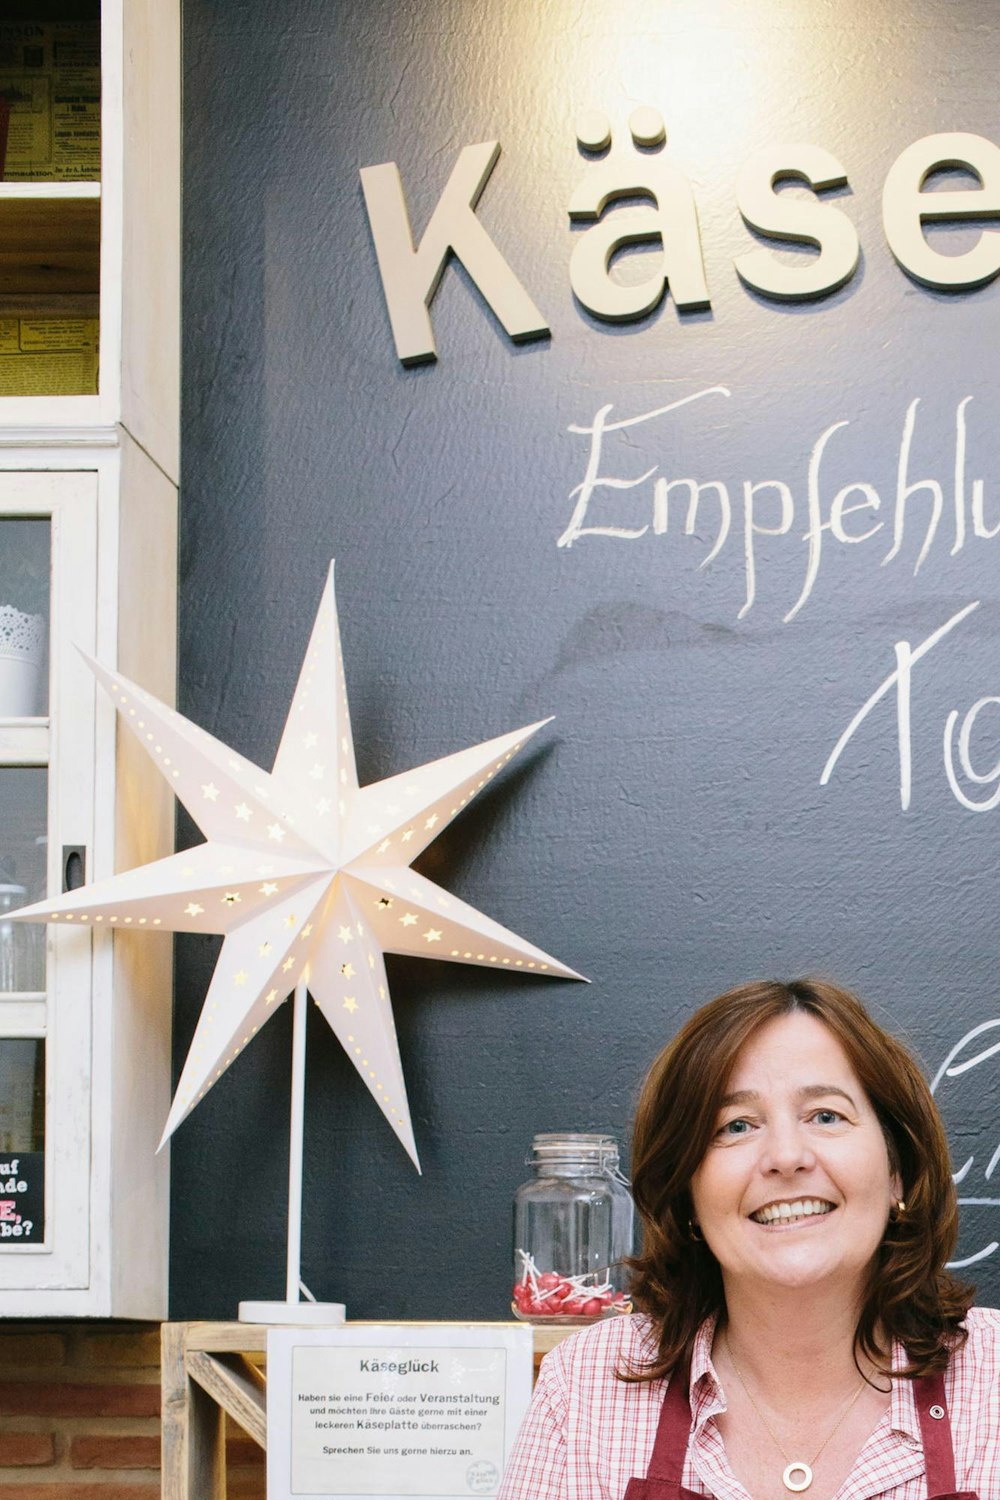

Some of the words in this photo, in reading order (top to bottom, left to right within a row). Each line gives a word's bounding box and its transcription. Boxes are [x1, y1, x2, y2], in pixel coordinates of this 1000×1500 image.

[360, 1358, 439, 1375] Käseglück
[298, 1393, 326, 1402] Haben
[366, 1392, 394, 1403] Feier
[397, 1394, 417, 1402] oder
[420, 1392, 500, 1405] Veranstaltung
[310, 1407, 326, 1415] und
[328, 1407, 367, 1415] möchten
[370, 1407, 386, 1416] Ihre
[389, 1407, 415, 1416] Gäste
[418, 1409, 444, 1417] gerne
[447, 1408, 462, 1416] mit
[464, 1408, 488, 1416] einer
[315, 1421, 354, 1430] leckeren
[356, 1419, 418, 1431] Käseplatte
[421, 1421, 482, 1431] überraschen?
[322, 1446, 364, 1455] Sprechen
[366, 1446, 381, 1454] Sie
[383, 1447, 399, 1455] uns
[401, 1447, 427, 1456] gerne
[430, 1447, 457, 1455] hierzu
[459, 1448, 473, 1456] an.
